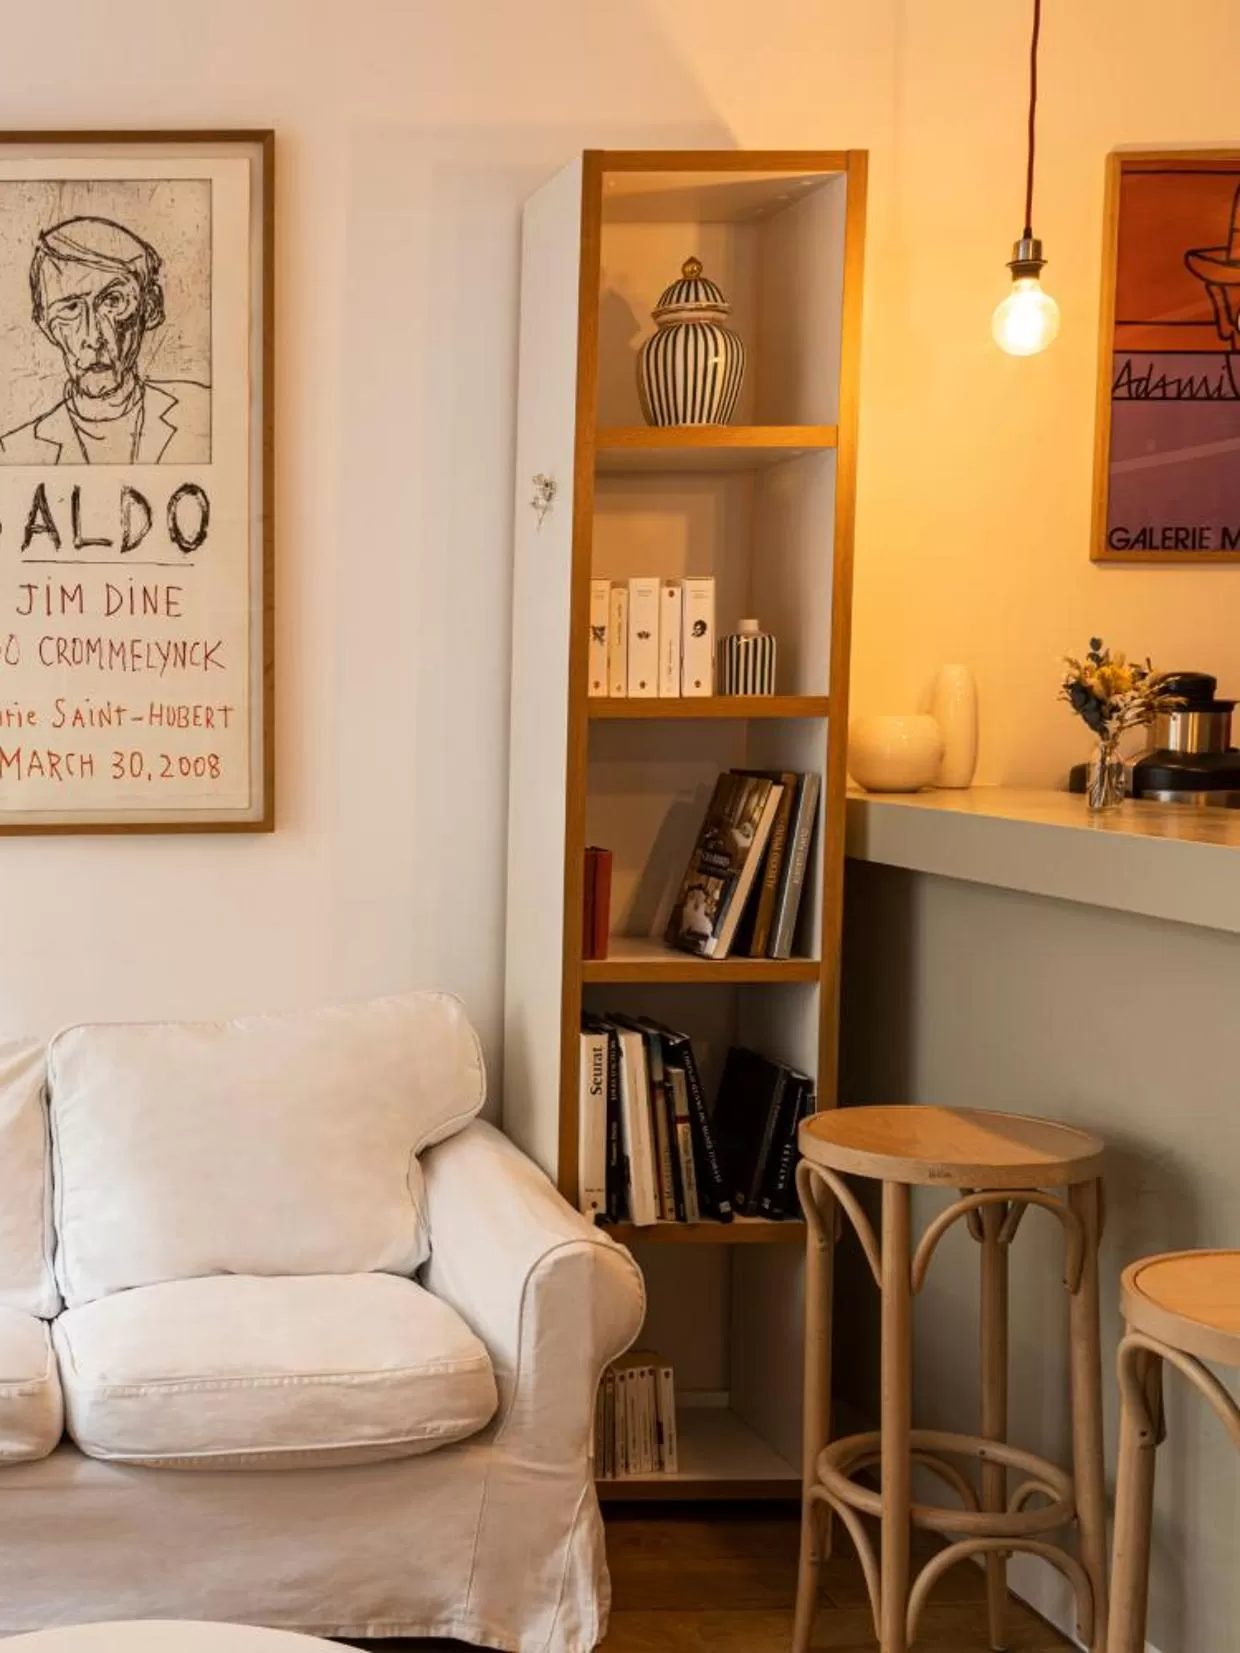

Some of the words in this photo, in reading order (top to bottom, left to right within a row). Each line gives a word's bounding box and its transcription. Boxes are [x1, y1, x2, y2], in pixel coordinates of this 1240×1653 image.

[21, 482, 211, 554] ALDO
[1107, 527, 1213, 551] GALERIE
[38, 635, 227, 678] CROMMELYNCK
[589, 1046, 604, 1096] Seurat
